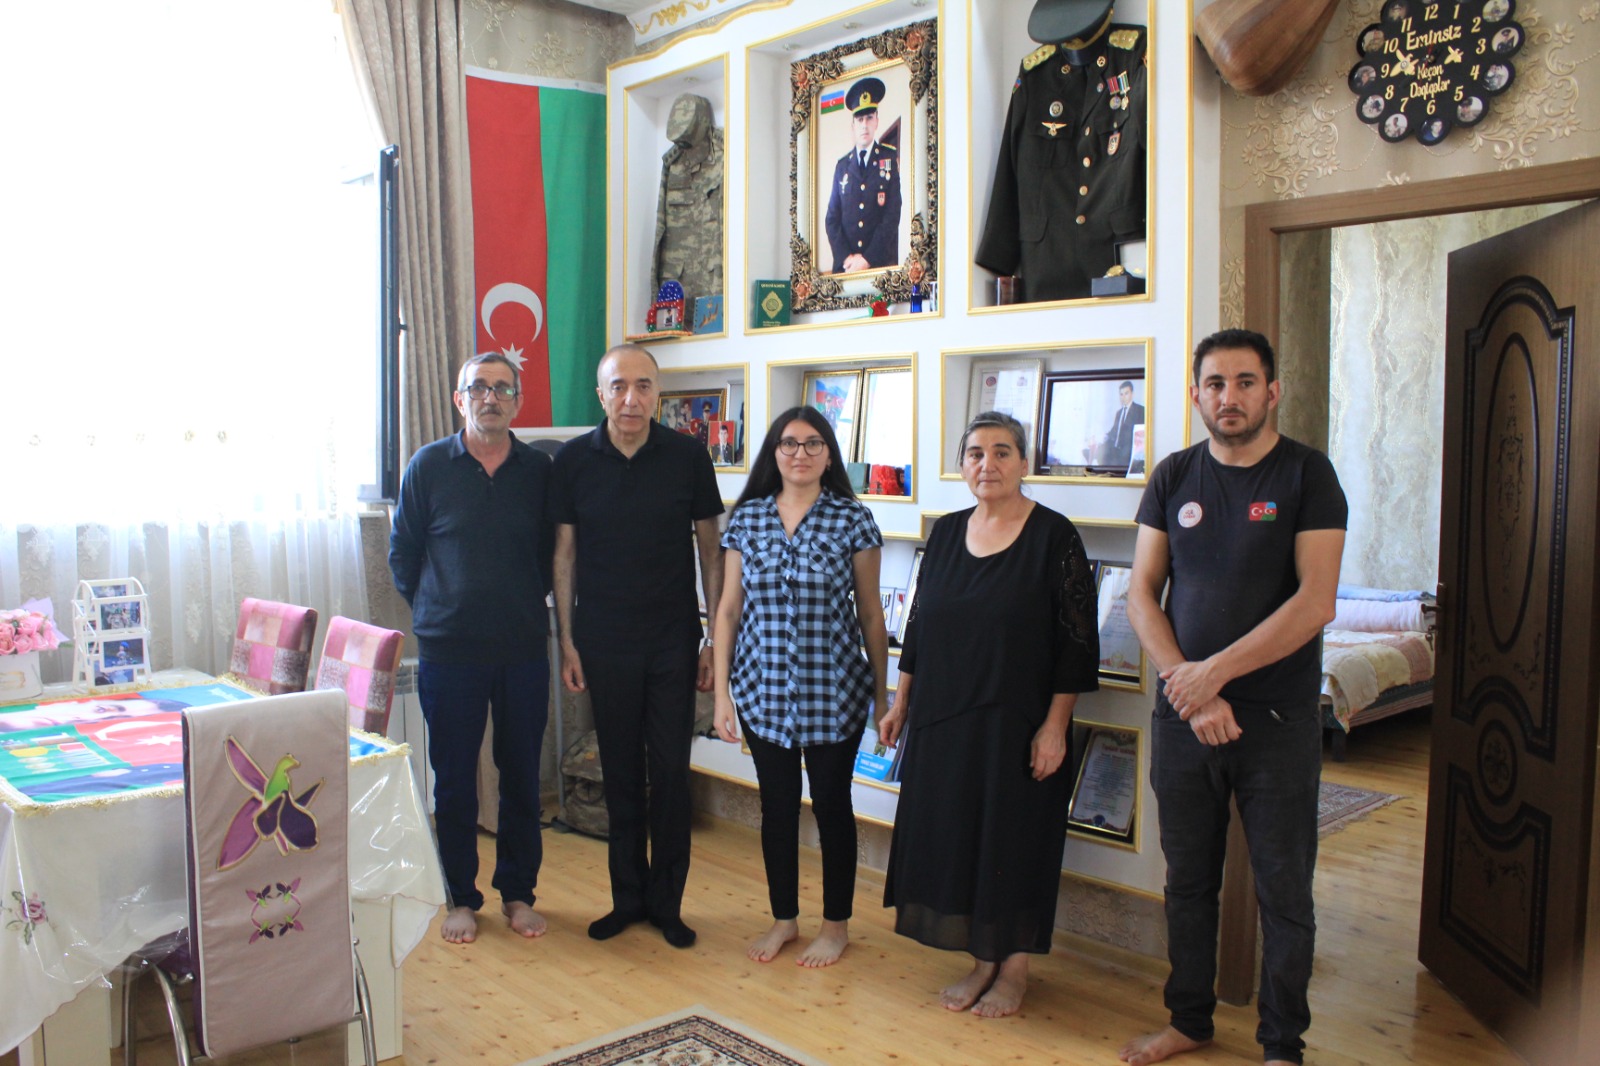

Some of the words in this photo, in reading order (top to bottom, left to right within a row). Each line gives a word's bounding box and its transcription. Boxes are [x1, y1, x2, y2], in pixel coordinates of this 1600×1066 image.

[1425, 4, 1438, 21] 12
[1454, 5, 1459, 20] 1
[1402, 17, 1412, 33] 11
[1472, 17, 1481, 33] 2
[1384, 38, 1398, 54] 10
[1476, 39, 1486, 55] 3
[1382, 64, 1389, 79] 9
[1471, 65, 1479, 81] 4
[1385, 85, 1394, 100] 8
[1454, 86, 1463, 102] 5
[1401, 98, 1409, 113] 7
[1427, 100, 1435, 115] 6
